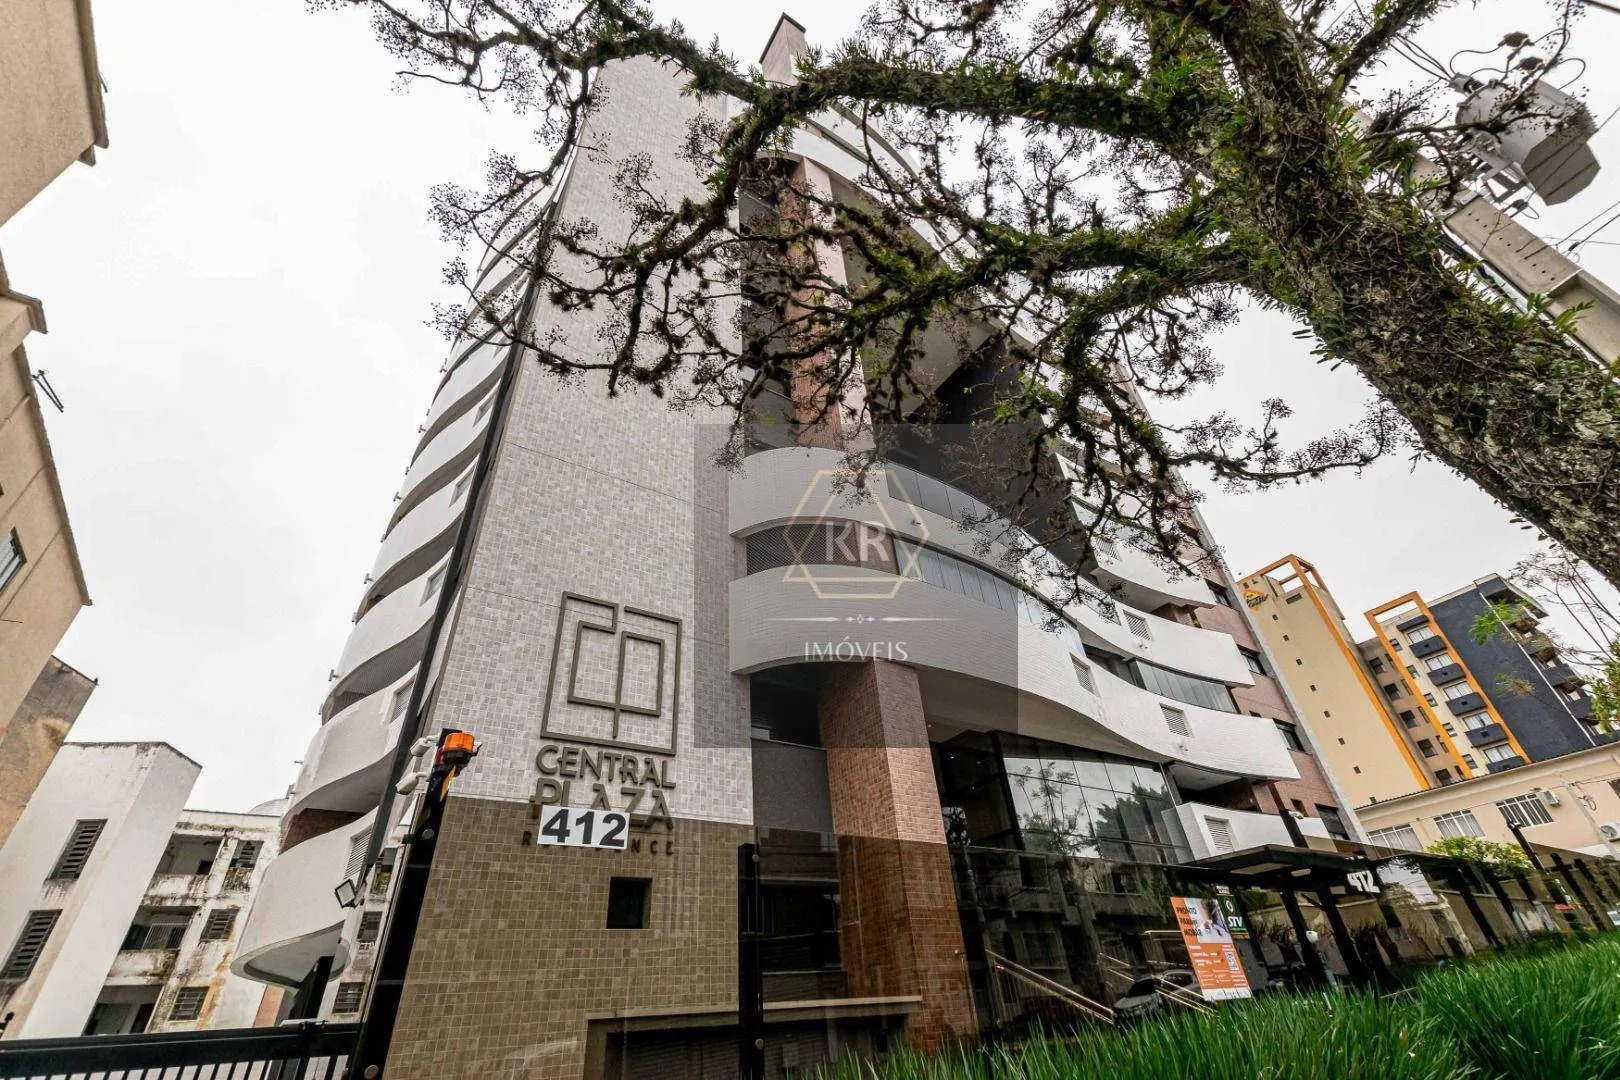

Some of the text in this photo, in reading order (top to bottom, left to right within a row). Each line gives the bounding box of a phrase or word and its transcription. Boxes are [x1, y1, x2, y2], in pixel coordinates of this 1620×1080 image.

[536, 744, 676, 789] CENTRAL
[542, 808, 627, 848] 412
[1347, 870, 1380, 893] 412
